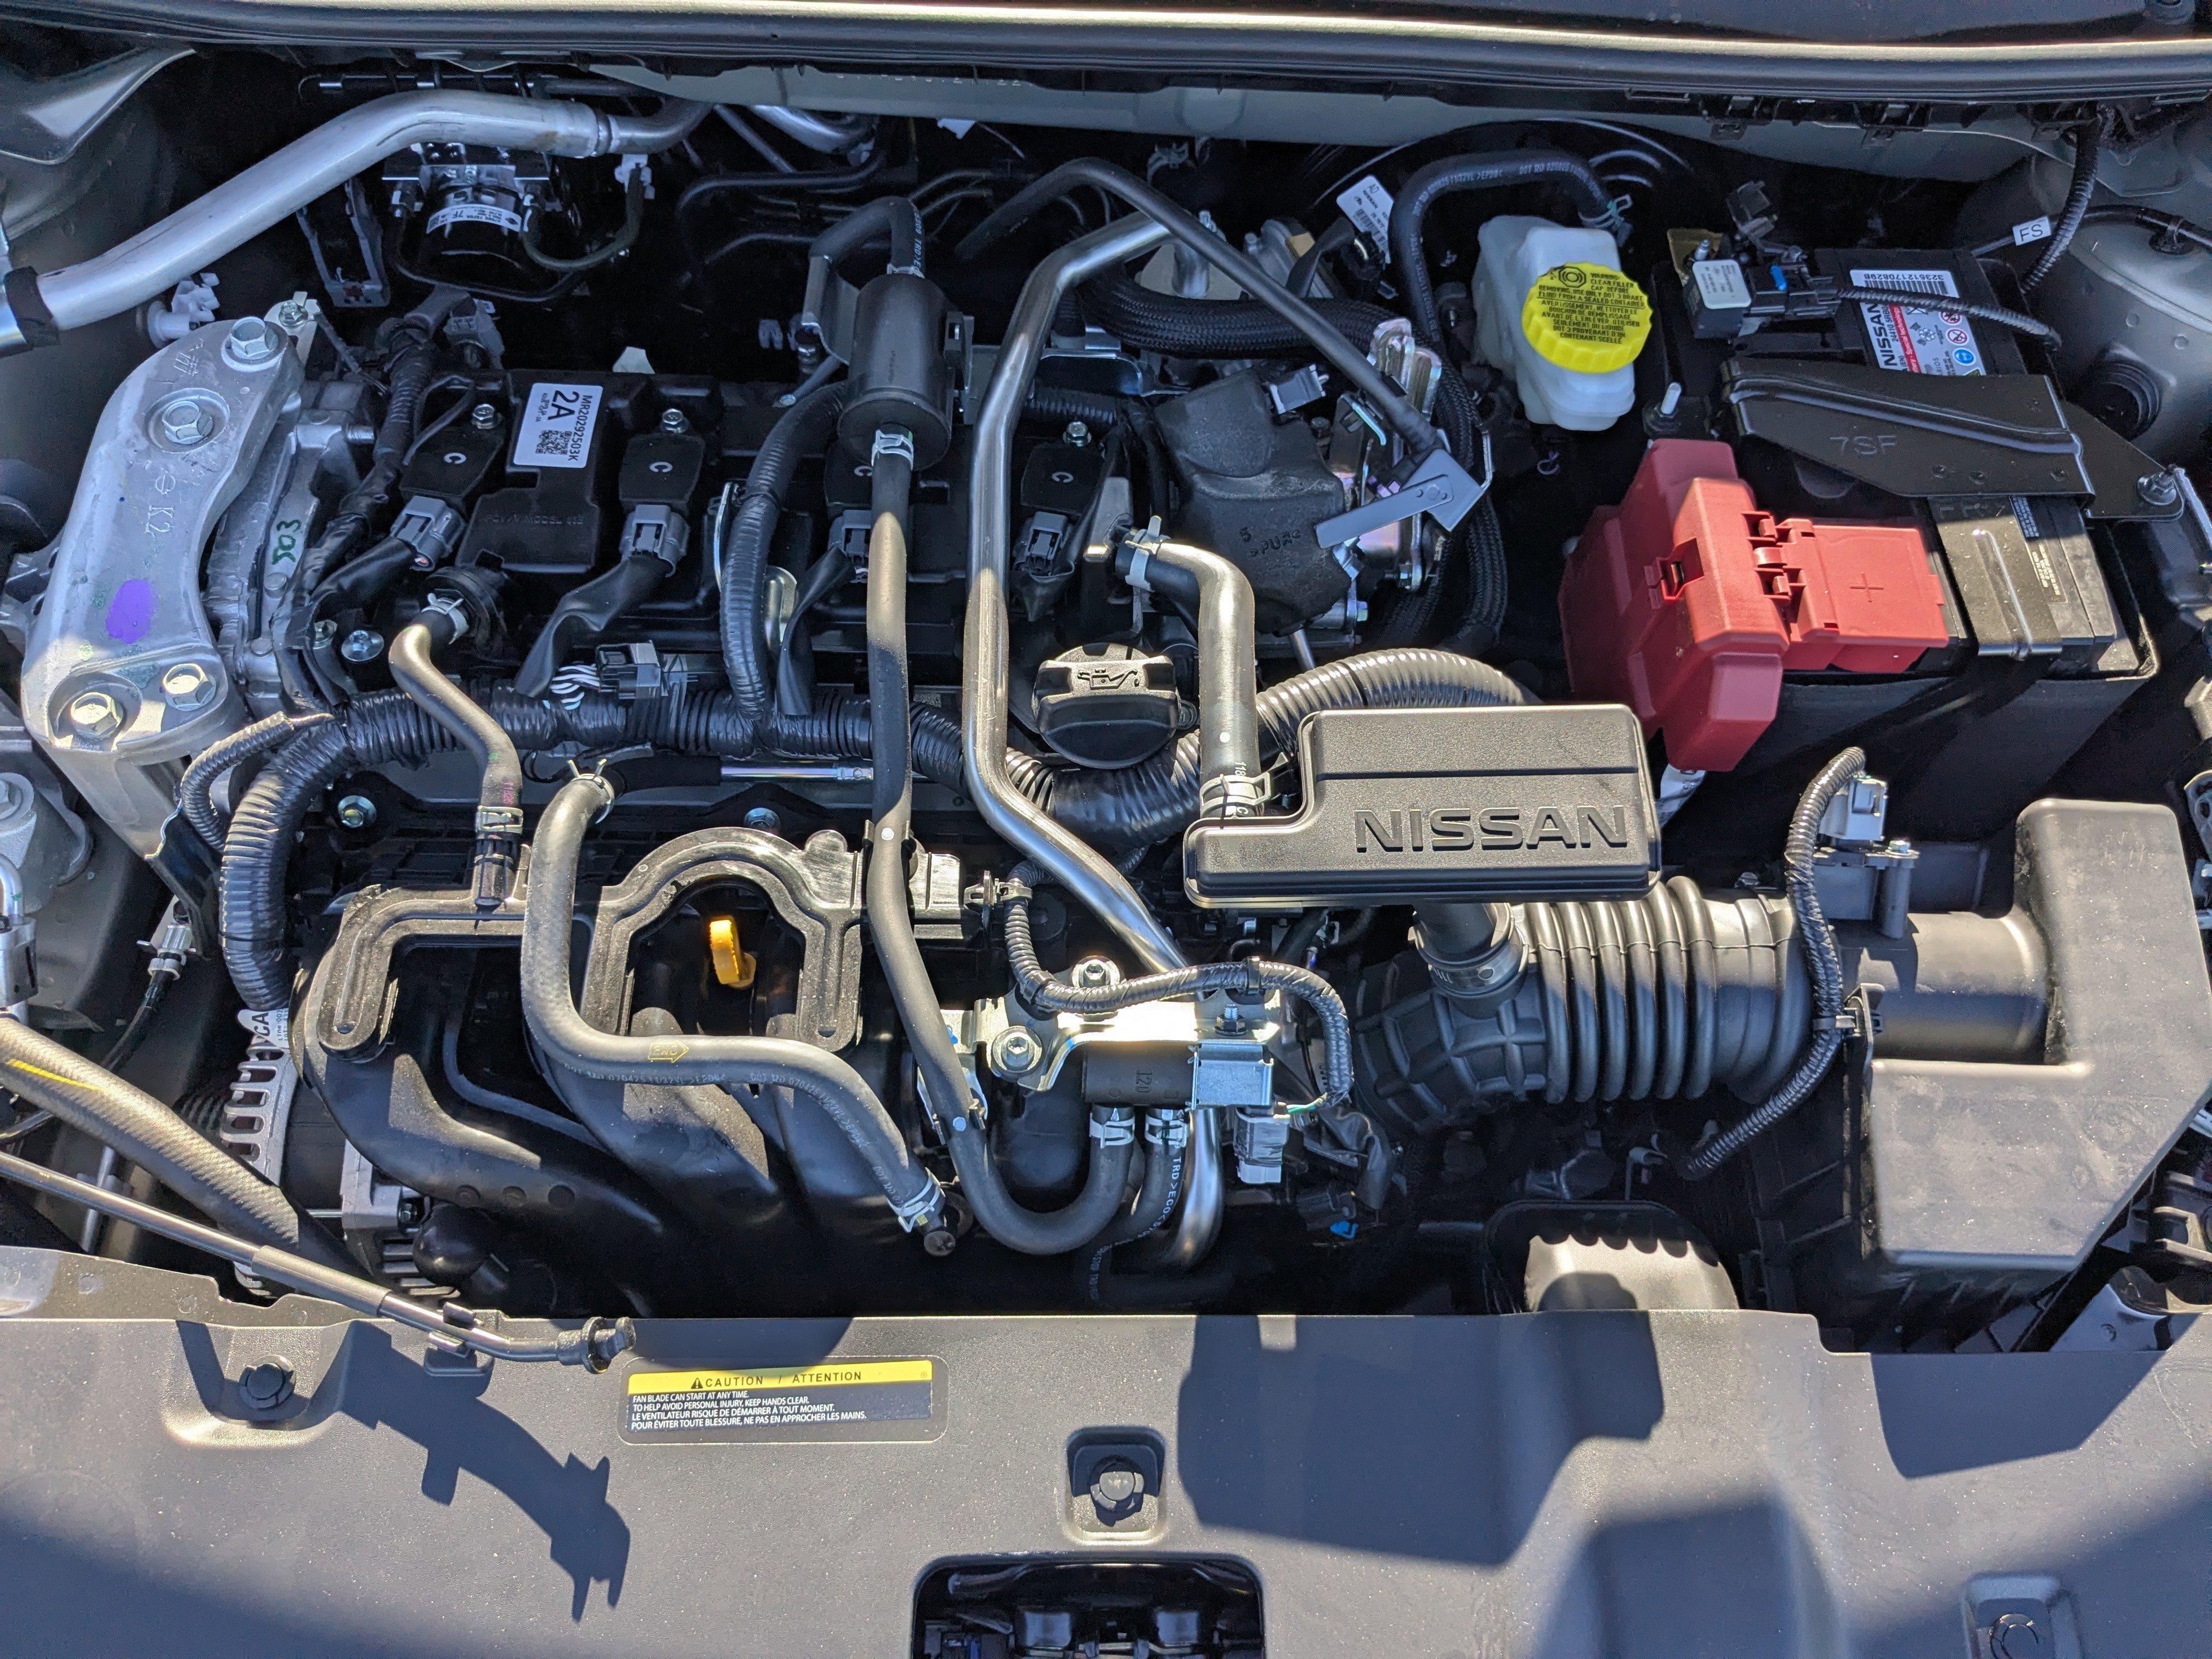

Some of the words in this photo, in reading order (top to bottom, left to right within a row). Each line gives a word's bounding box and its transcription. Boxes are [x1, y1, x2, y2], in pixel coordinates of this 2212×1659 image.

[2019, 224, 2044, 242] FS
[1588, 311, 1631, 320] REMPLISSAGE
[1597, 306, 1629, 314] NETTOYER
[1553, 319, 1589, 328] SEULEMENT
[1572, 327, 1610, 336] PROVENANT
[1560, 332, 1596, 342] CONTENANT
[1866, 303, 1898, 366] NISSAN
[547, 390, 580, 421] 2A
[568, 395, 593, 461] MR20292503K
[1830, 434, 1897, 456] 7SF
[1353, 805, 1628, 854] NISSAN
[1171, 1155, 1182, 1180] TRD
[706, 1376, 763, 1387] CAUTION
[792, 1371, 861, 1384] ATTENTION
[634, 1403, 643, 1412] TO
[644, 1403, 661, 1412] HELP
[662, 1401, 683, 1410] AVOID
[685, 1400, 719, 1409] PERSONAL
[720, 1399, 744, 1409] INJURY,
[744, 1398, 761, 1407] KEEP
[762, 1397, 786, 1406] HANDS
[787, 1396, 810, 1404] CLEAR.
[647, 1394, 669, 1402] BLADE
[670, 1393, 685, 1401] CAN
[686, 1392, 706, 1401] START
[707, 1392, 716, 1400] AT
[717, 1391, 731, 1400] ANY
[732, 1390, 749, 1398] TIME.
[631, 1421, 653, 1430] POUR
[653, 1419, 679, 1429] ÉVITER
[680, 1419, 704, 1428] TOUTE
[705, 1417, 742, 1427] BLESSURE,
[743, 1417, 755, 1425] NE
[755, 1415, 769, 1425] PAS
[770, 1414, 781, 1423] EN
[781, 1412, 827, 1423] APPROCHER
[827, 1411, 840, 1420] LES
[840, 1410, 867, 1420] MAINS.
[632, 1413, 641, 1421] LE
[641, 1409, 691, 1421] VENTILATEUR
[691, 1408, 719, 1418] RISQUE
[719, 1408, 730, 1417] DE
[731, 1406, 771, 1417] DÉMARRER
[772, 1404, 778, 1414] À
[779, 1405, 798, 1414] TOUT
[800, 1403, 836, 1413] MOMENT.
